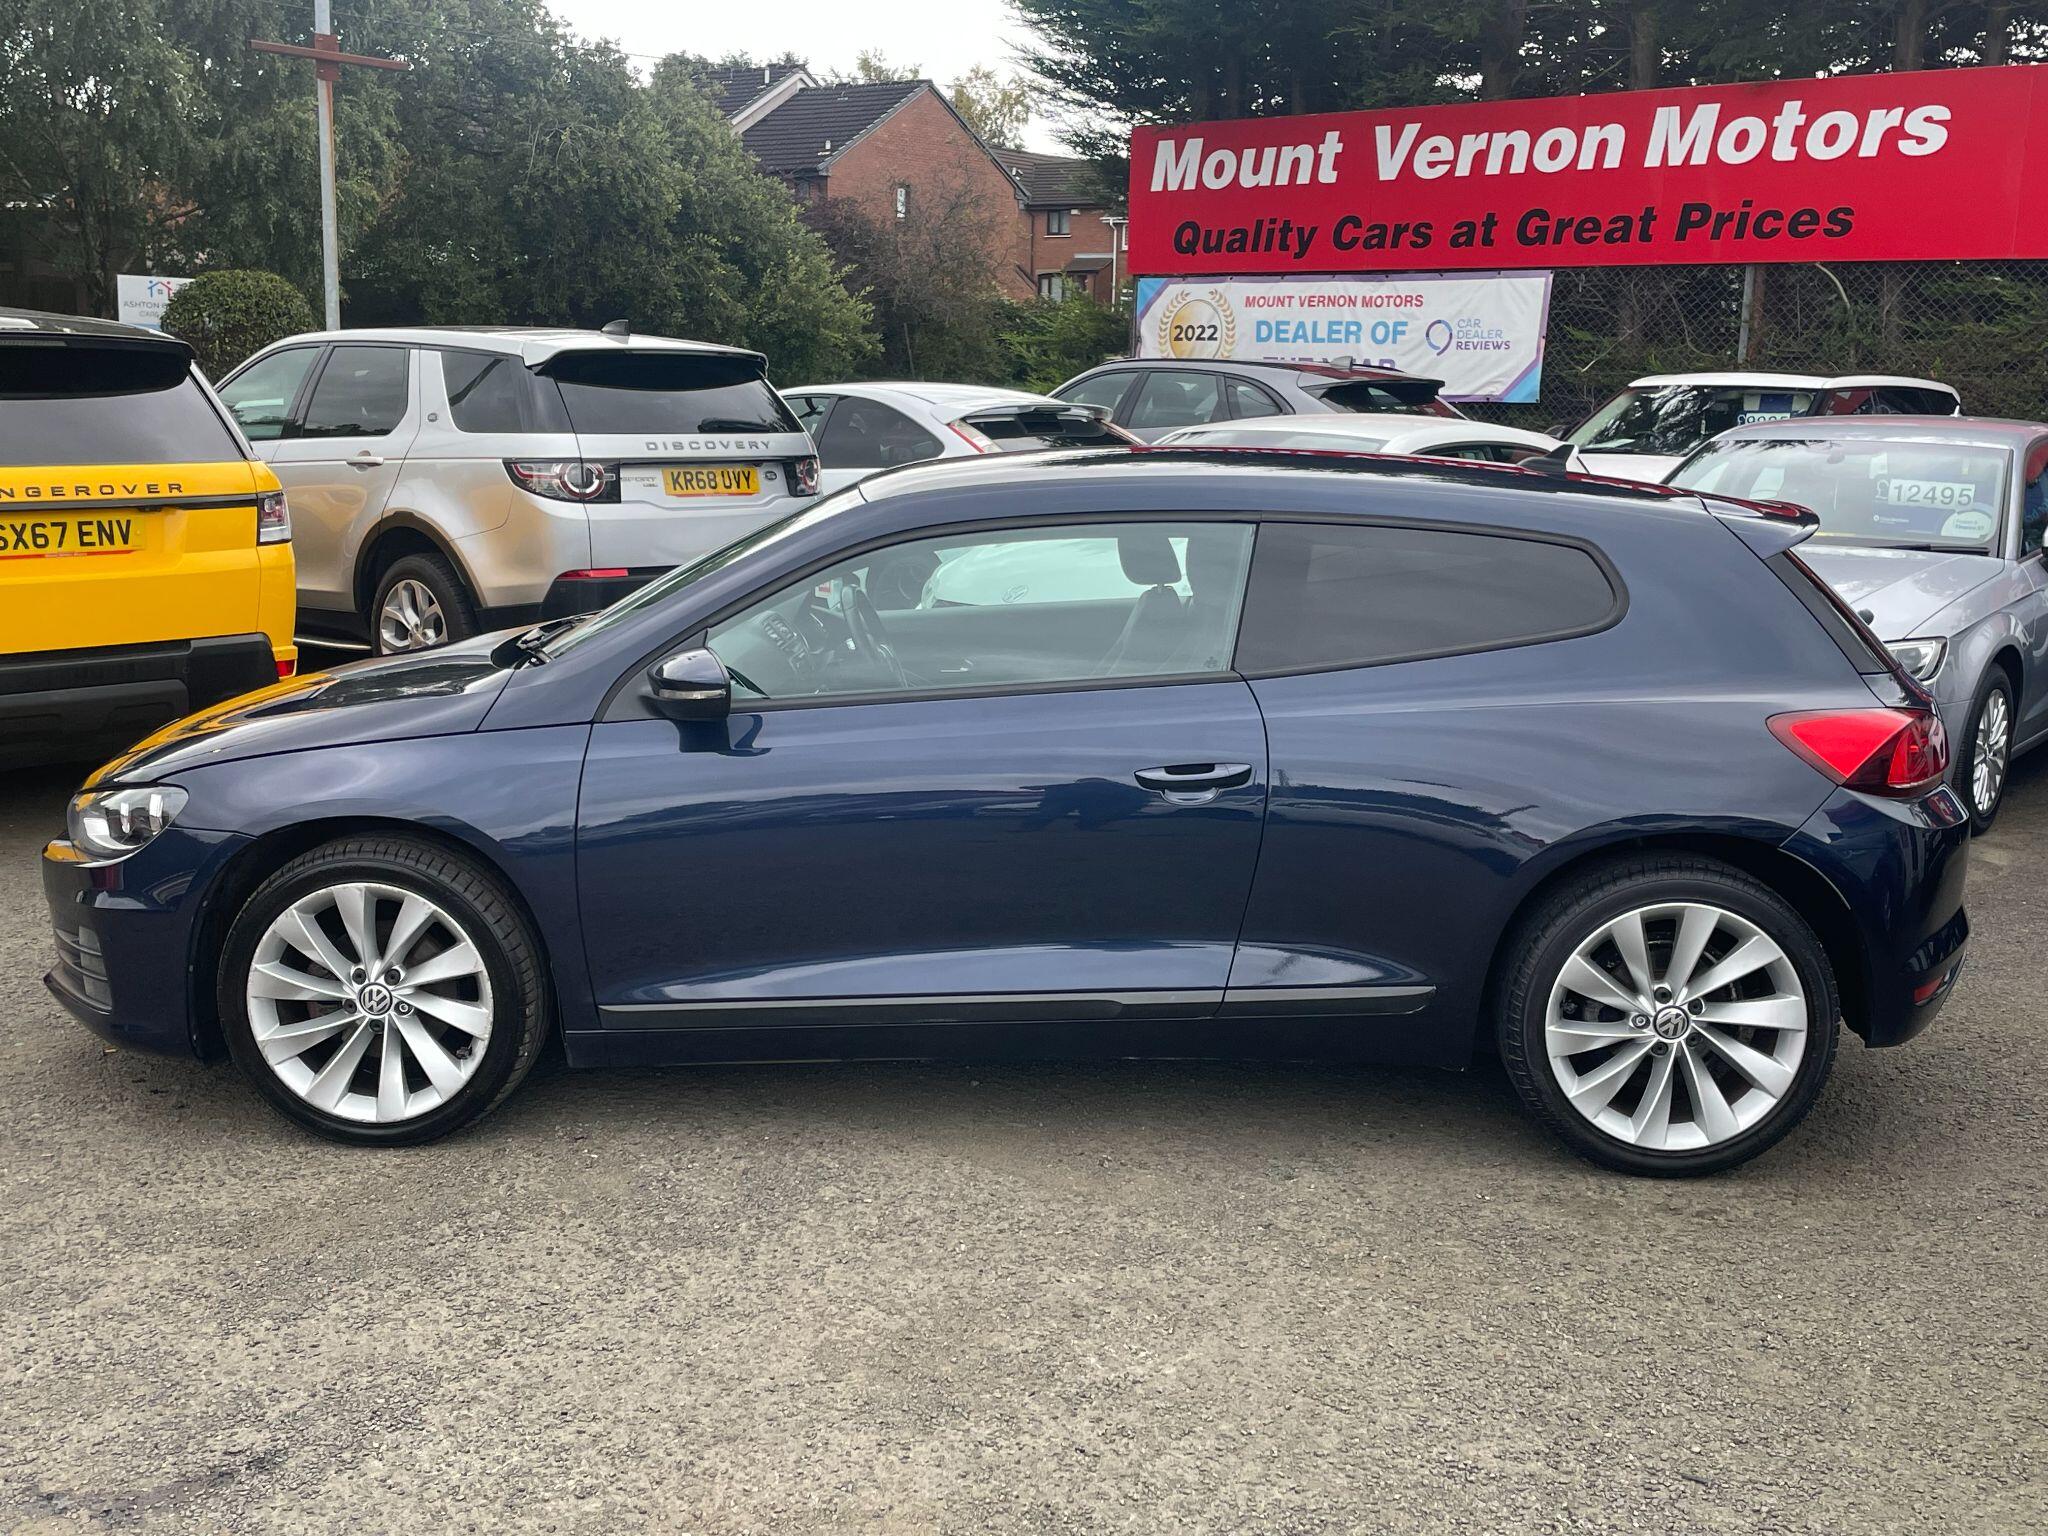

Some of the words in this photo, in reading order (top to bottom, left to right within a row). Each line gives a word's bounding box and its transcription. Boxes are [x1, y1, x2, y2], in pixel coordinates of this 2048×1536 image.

[1150, 131, 1344, 192] Mount
[1375, 122, 1627, 182] Vernon
[1643, 100, 1952, 169] Motors
[1173, 218, 1318, 260] Quality
[1332, 214, 1433, 251] Cars
[1449, 212, 1498, 248] at
[1516, 206, 1657, 246] Great
[1674, 200, 1855, 242] Prices
[123, 301, 160, 309] ASHTON
[1244, 295, 1295, 308] MOUNT
[1298, 295, 1357, 308] VERNON
[1361, 294, 1424, 308] MOTORS
[1457, 318, 1482, 329] CAR
[1173, 324, 1218, 342] 2022
[1255, 320, 1362, 344] DEALER
[1370, 320, 1409, 345] OF
[1456, 329, 1504, 340] DEALER
[1455, 340, 1511, 351] REVIEWS
[645, 440, 771, 451] DISCOVERY
[670, 470, 718, 491] KR68
[720, 470, 751, 490] UVY
[77, 519, 132, 547] ENV
